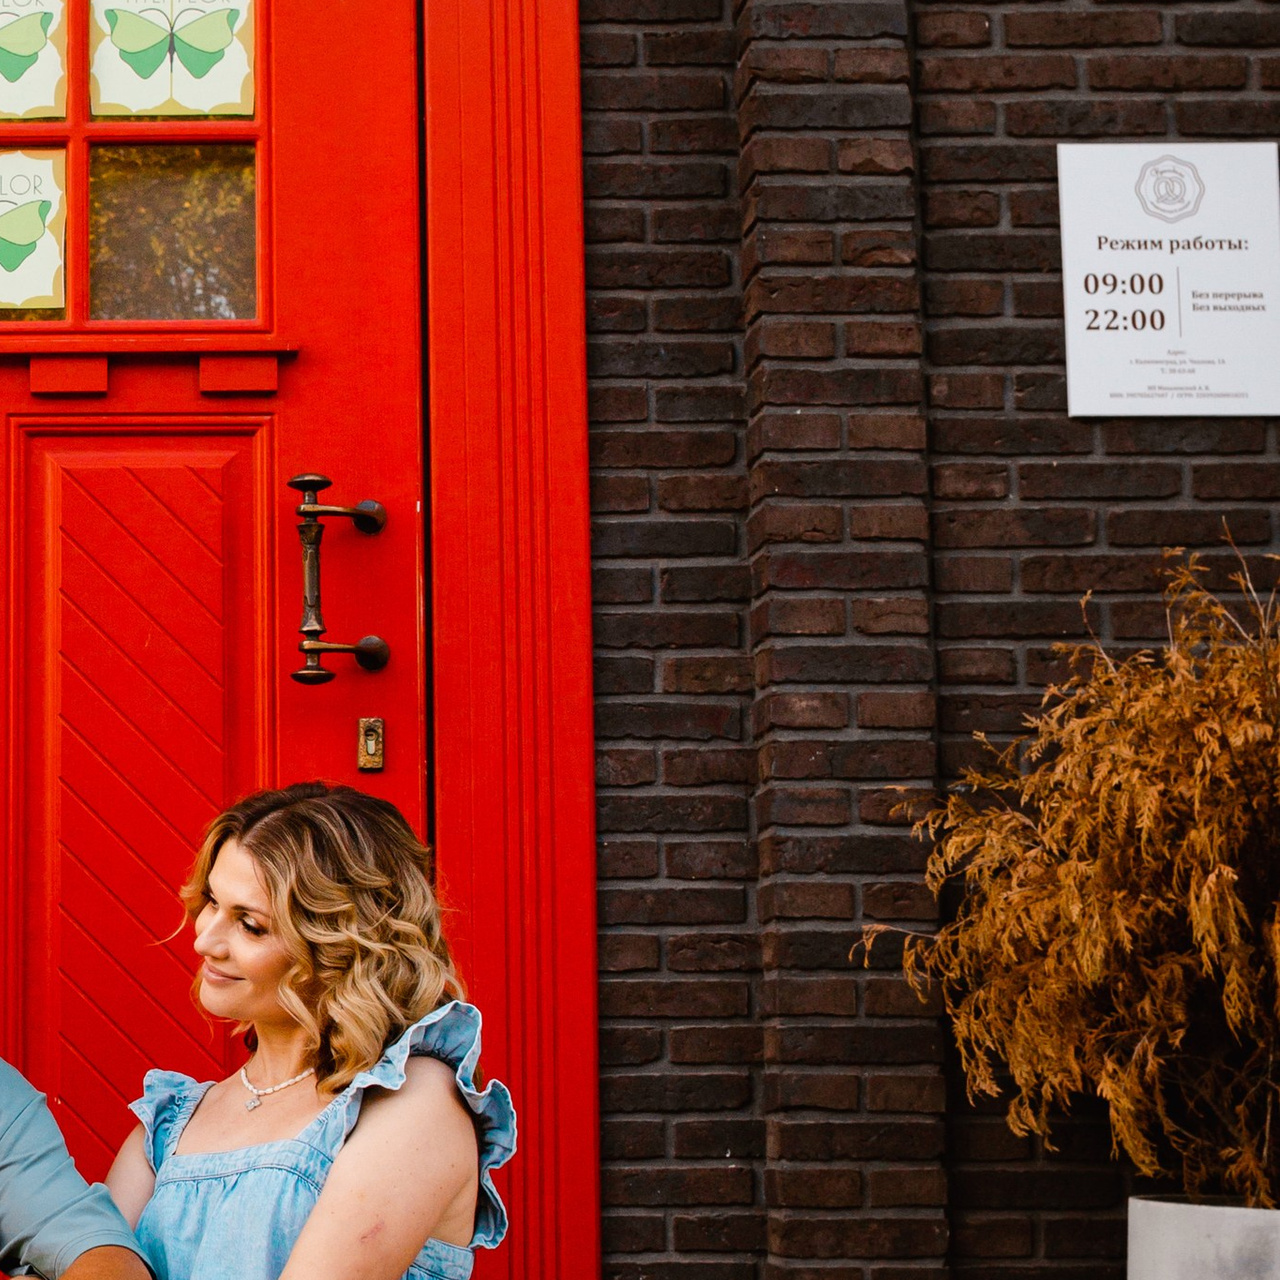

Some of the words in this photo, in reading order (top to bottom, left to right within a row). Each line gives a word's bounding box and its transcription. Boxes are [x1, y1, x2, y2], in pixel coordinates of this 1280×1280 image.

[1096, 235, 1164, 251] Режим
[1169, 235, 1249, 255] работы:
[1083, 272, 1165, 295] 09:00
[1191, 290, 1210, 299] Без
[1212, 291, 1264, 301] перерыва
[1192, 302, 1210, 311] Без
[1212, 304, 1267, 312] выходных
[1084, 308, 1166, 331] 22:00
